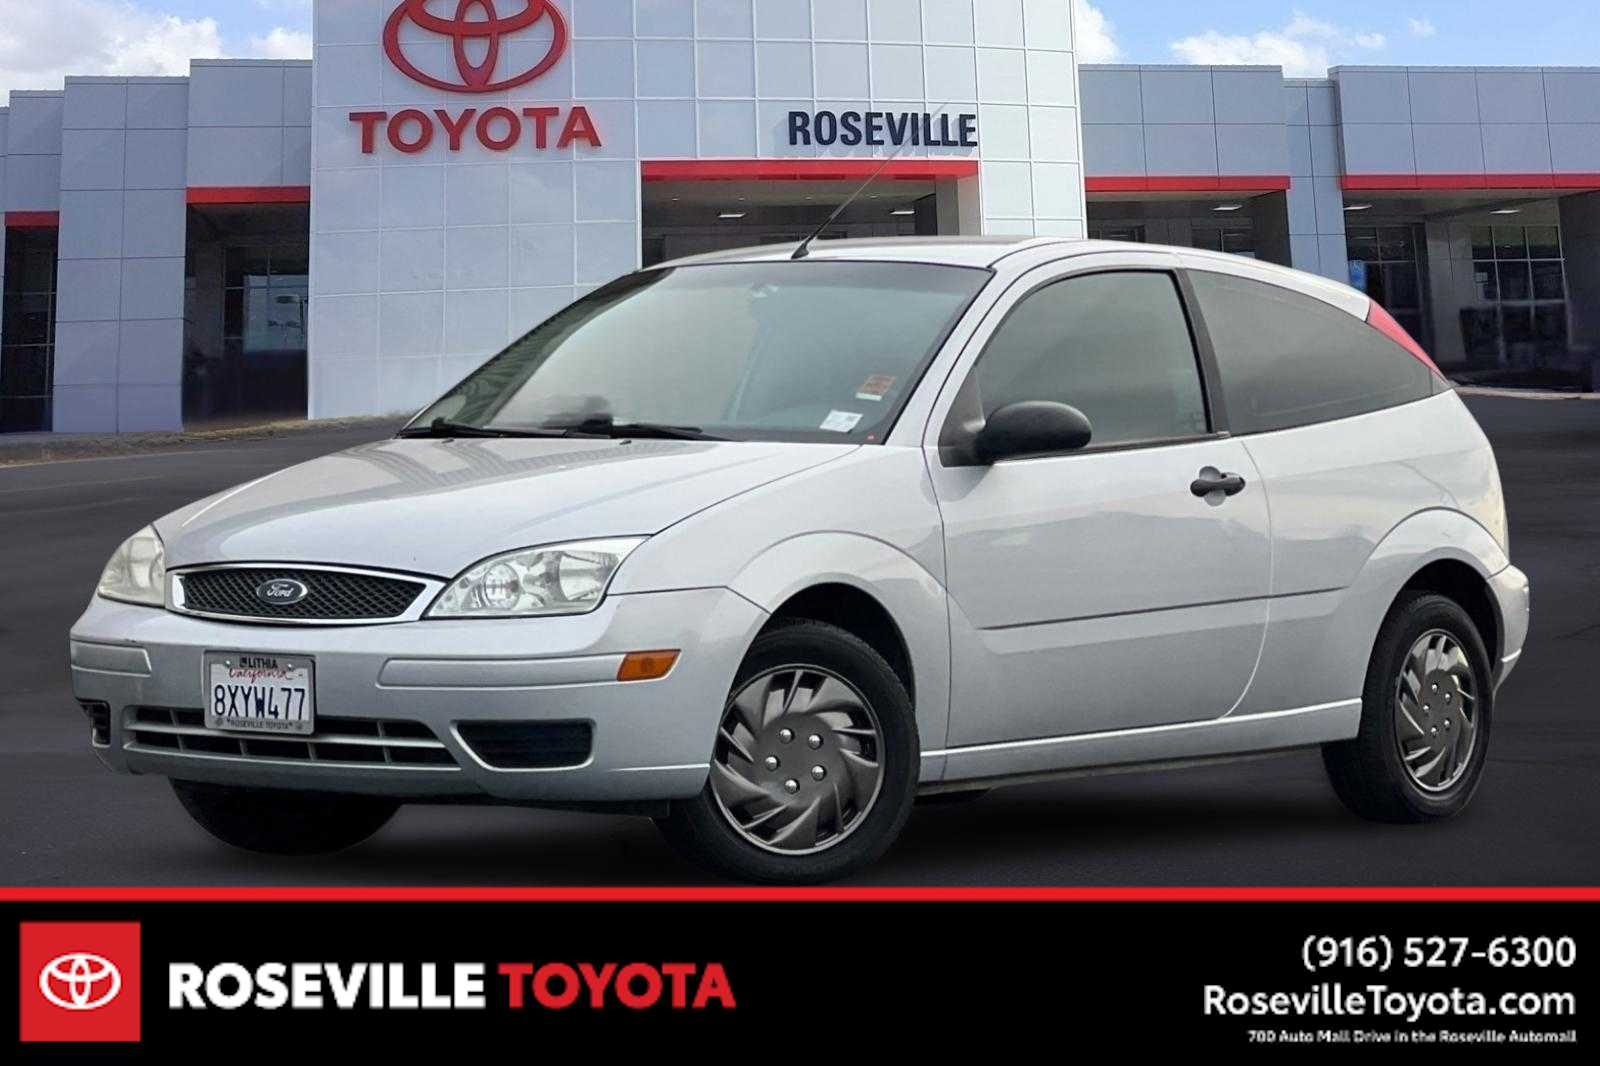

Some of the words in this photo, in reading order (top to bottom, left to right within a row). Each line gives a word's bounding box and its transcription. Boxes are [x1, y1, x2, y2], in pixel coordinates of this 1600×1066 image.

[349, 106, 602, 154] TOYOTA
[788, 110, 978, 147] ROSEVILLE
[266, 583, 294, 597] Ford
[214, 684, 306, 721] 8XYW477
